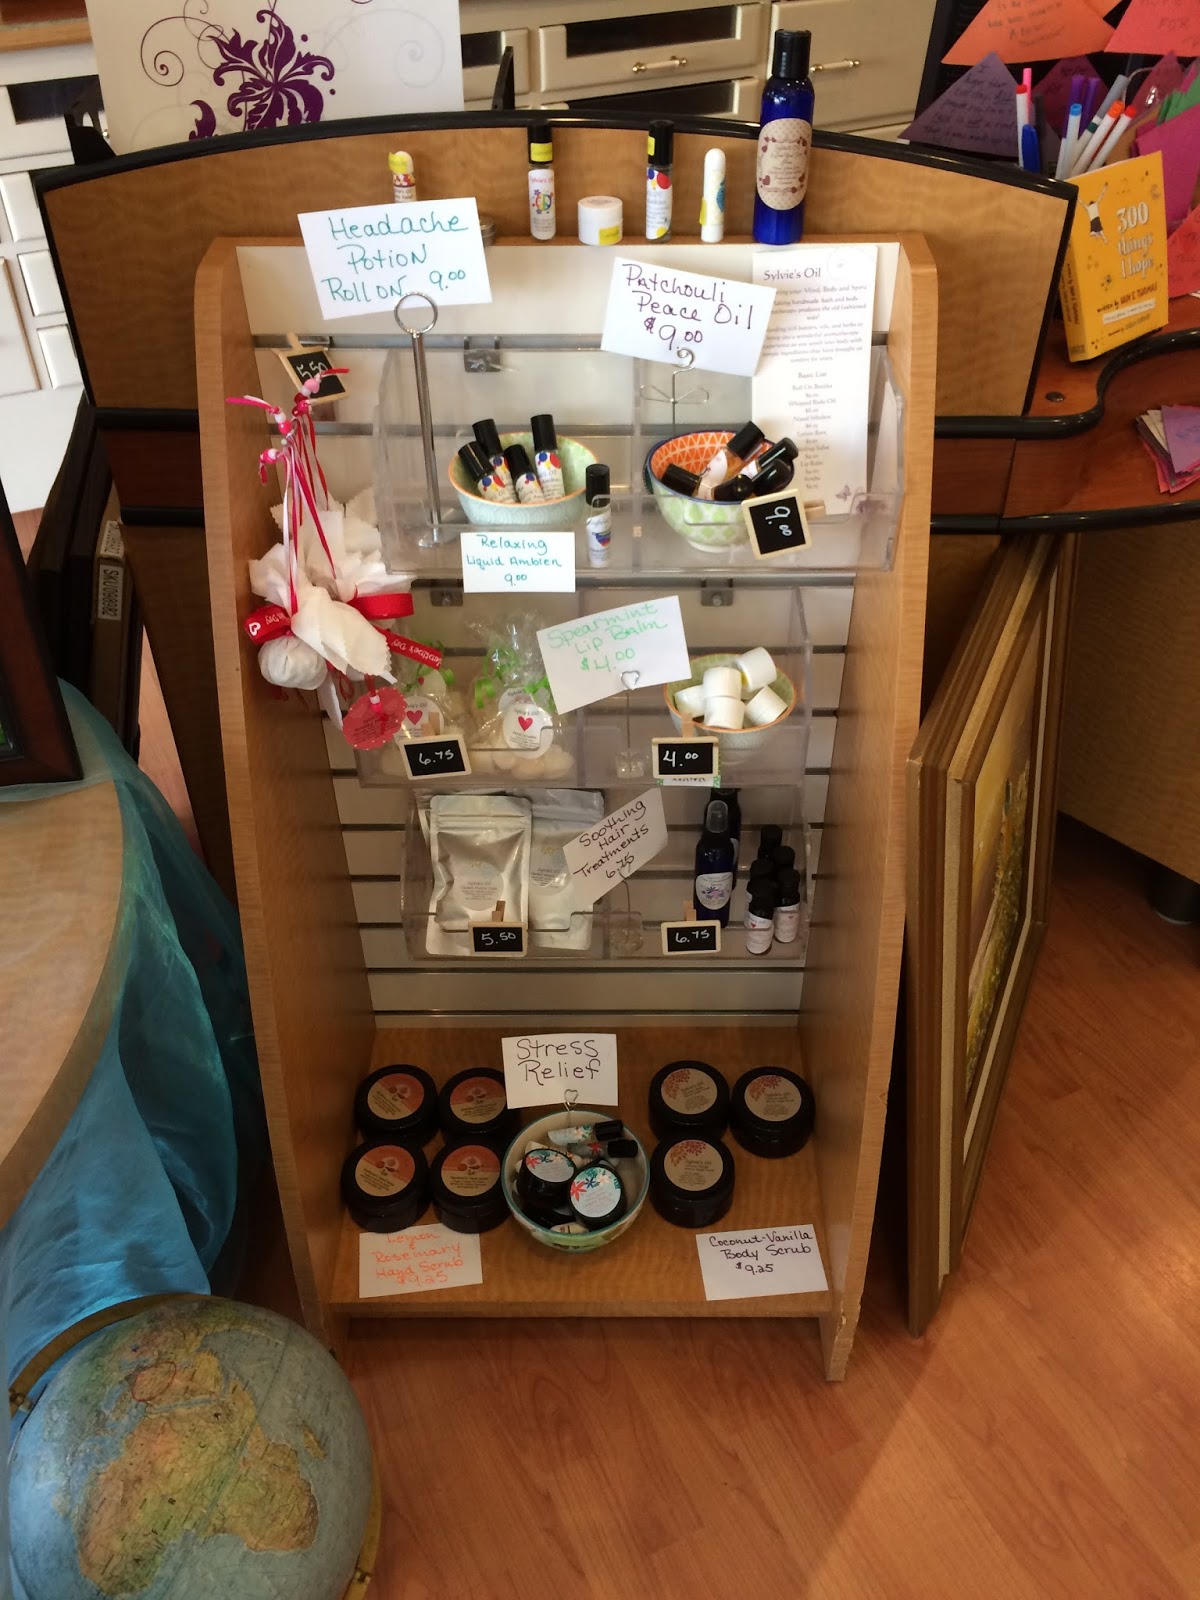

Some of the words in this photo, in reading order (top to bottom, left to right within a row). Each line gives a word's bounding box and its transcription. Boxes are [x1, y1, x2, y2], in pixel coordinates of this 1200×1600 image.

[328, 211, 469, 240] Headache
[1117, 201, 1149, 233] 300
[622, 263, 725, 303] Patchouli
[764, 268, 801, 280] Sylvie's
[804, 268, 821, 278] Oil
[321, 277, 371, 302] Roll
[632, 290, 702, 321] Peace
[714, 303, 753, 330] Oil
[764, 506, 792, 536] 9.00
[476, 534, 548, 556] Relaxing
[466, 554, 505, 570] Liquid
[504, 574, 528, 587] 9.00
[547, 603, 658, 649] Spearmint
[605, 620, 668, 641] Balm
[419, 749, 454, 766] 6.75
[662, 750, 699, 768] 4.00
[579, 800, 646, 847] Soothing
[598, 824, 630, 850] Hair
[573, 824, 649, 877] Treatments
[481, 932, 517, 946] 5.50
[675, 930, 710, 944] 6.75
[516, 1038, 599, 1060] Stress
[518, 1058, 601, 1086] Relief
[370, 1242, 464, 1264] Rosemary
[720, 1248, 759, 1261] Body
[765, 1242, 812, 1256] Scrub
[376, 1264, 415, 1278] Hand
[418, 1257, 464, 1272] Scrub
